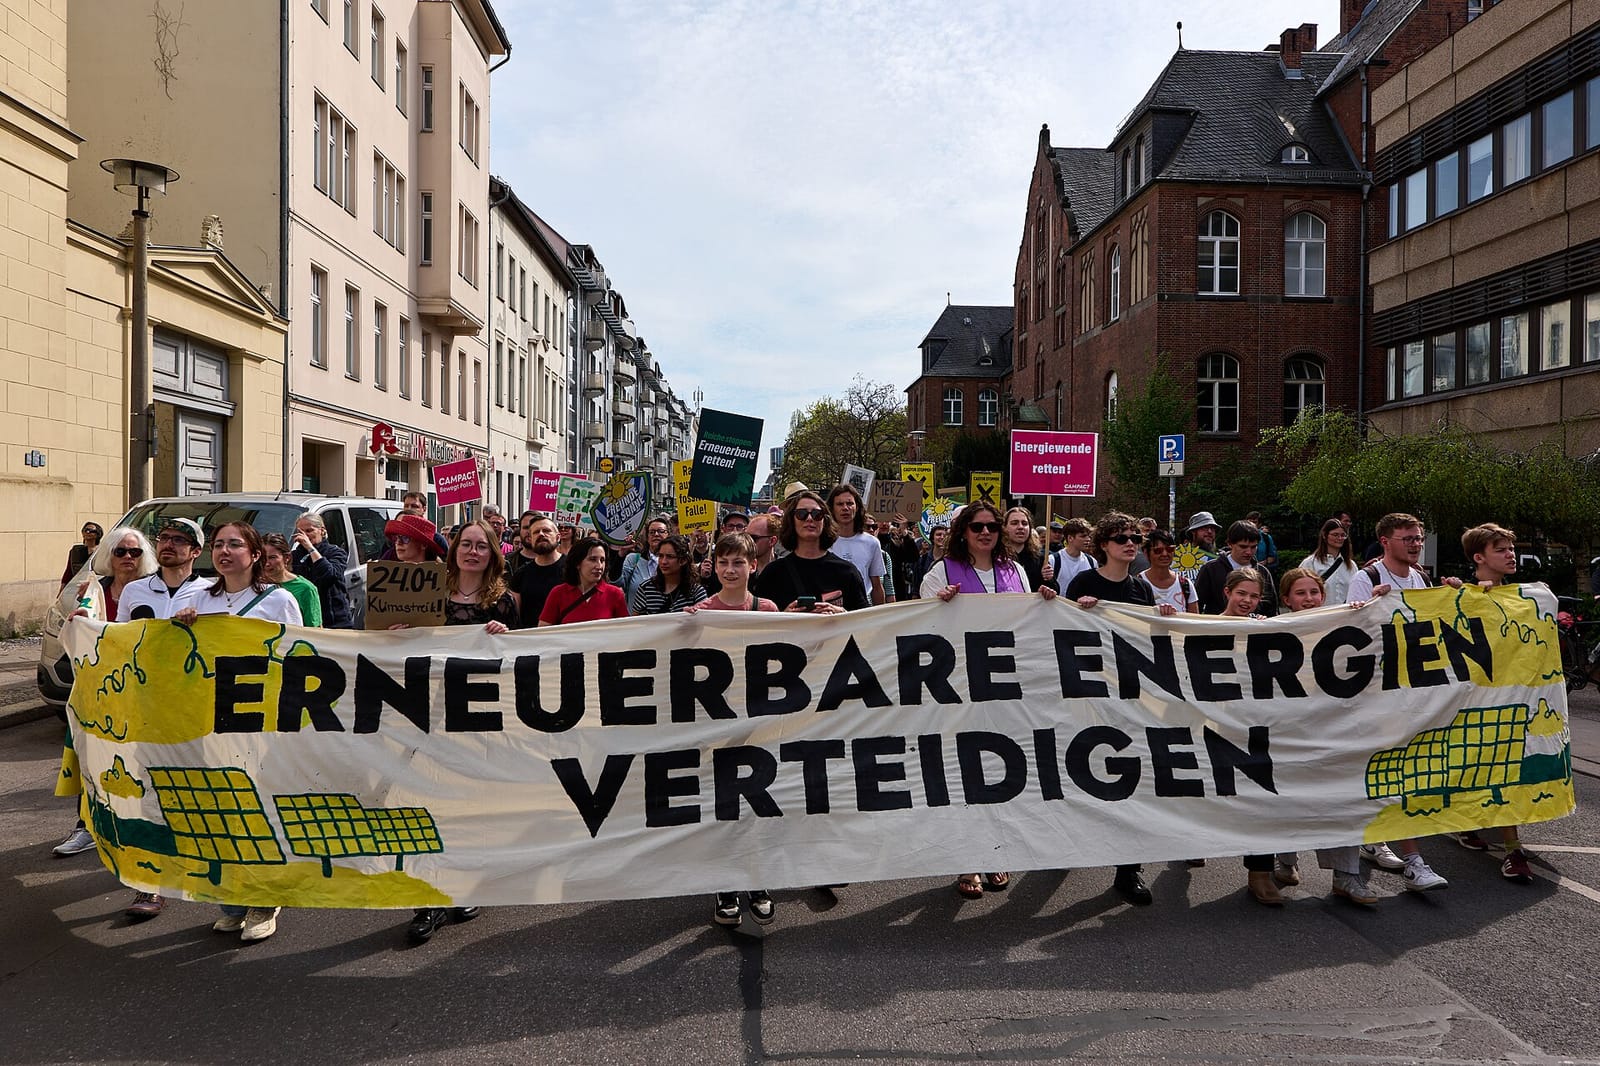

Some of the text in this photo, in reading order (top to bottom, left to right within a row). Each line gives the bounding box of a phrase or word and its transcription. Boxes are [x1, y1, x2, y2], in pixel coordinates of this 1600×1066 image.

[697, 439, 756, 460] Erneuerbare
[1014, 441, 1092, 455] Energiewende
[1163, 438, 1177, 459] P
[701, 455, 736, 469] retten!
[438, 470, 476, 486] CAMPACT
[875, 481, 904, 498] MERZ
[606, 487, 640, 518] FREUNDE
[685, 503, 707, 517] Falle!
[874, 499, 898, 513] LECK
[556, 511, 581, 526] Ende!
[605, 514, 620, 531] DER
[620, 495, 645, 521] SONNE
[368, 595, 442, 618] Klimastreik!
[214, 617, 1493, 733] ERNEUERBARE ENERGIEN
[550, 725, 1278, 838] VERTEIDIGEN
